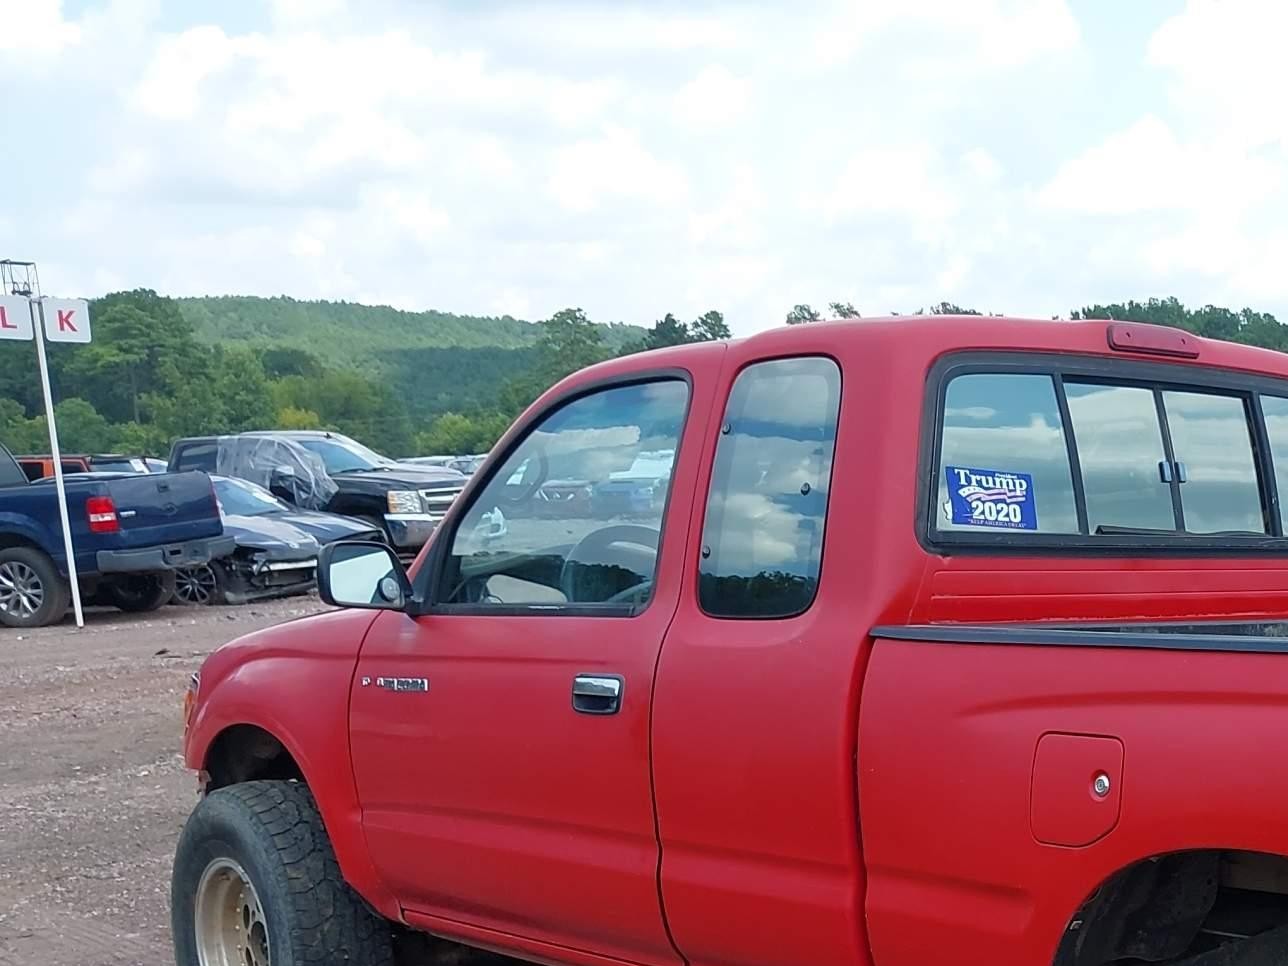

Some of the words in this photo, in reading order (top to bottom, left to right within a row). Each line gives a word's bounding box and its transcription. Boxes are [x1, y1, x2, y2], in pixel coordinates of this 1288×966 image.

[0, 306, 17, 329] L
[57, 309, 77, 332] K
[954, 468, 1027, 496] Trump
[971, 500, 1022, 523] 2020
